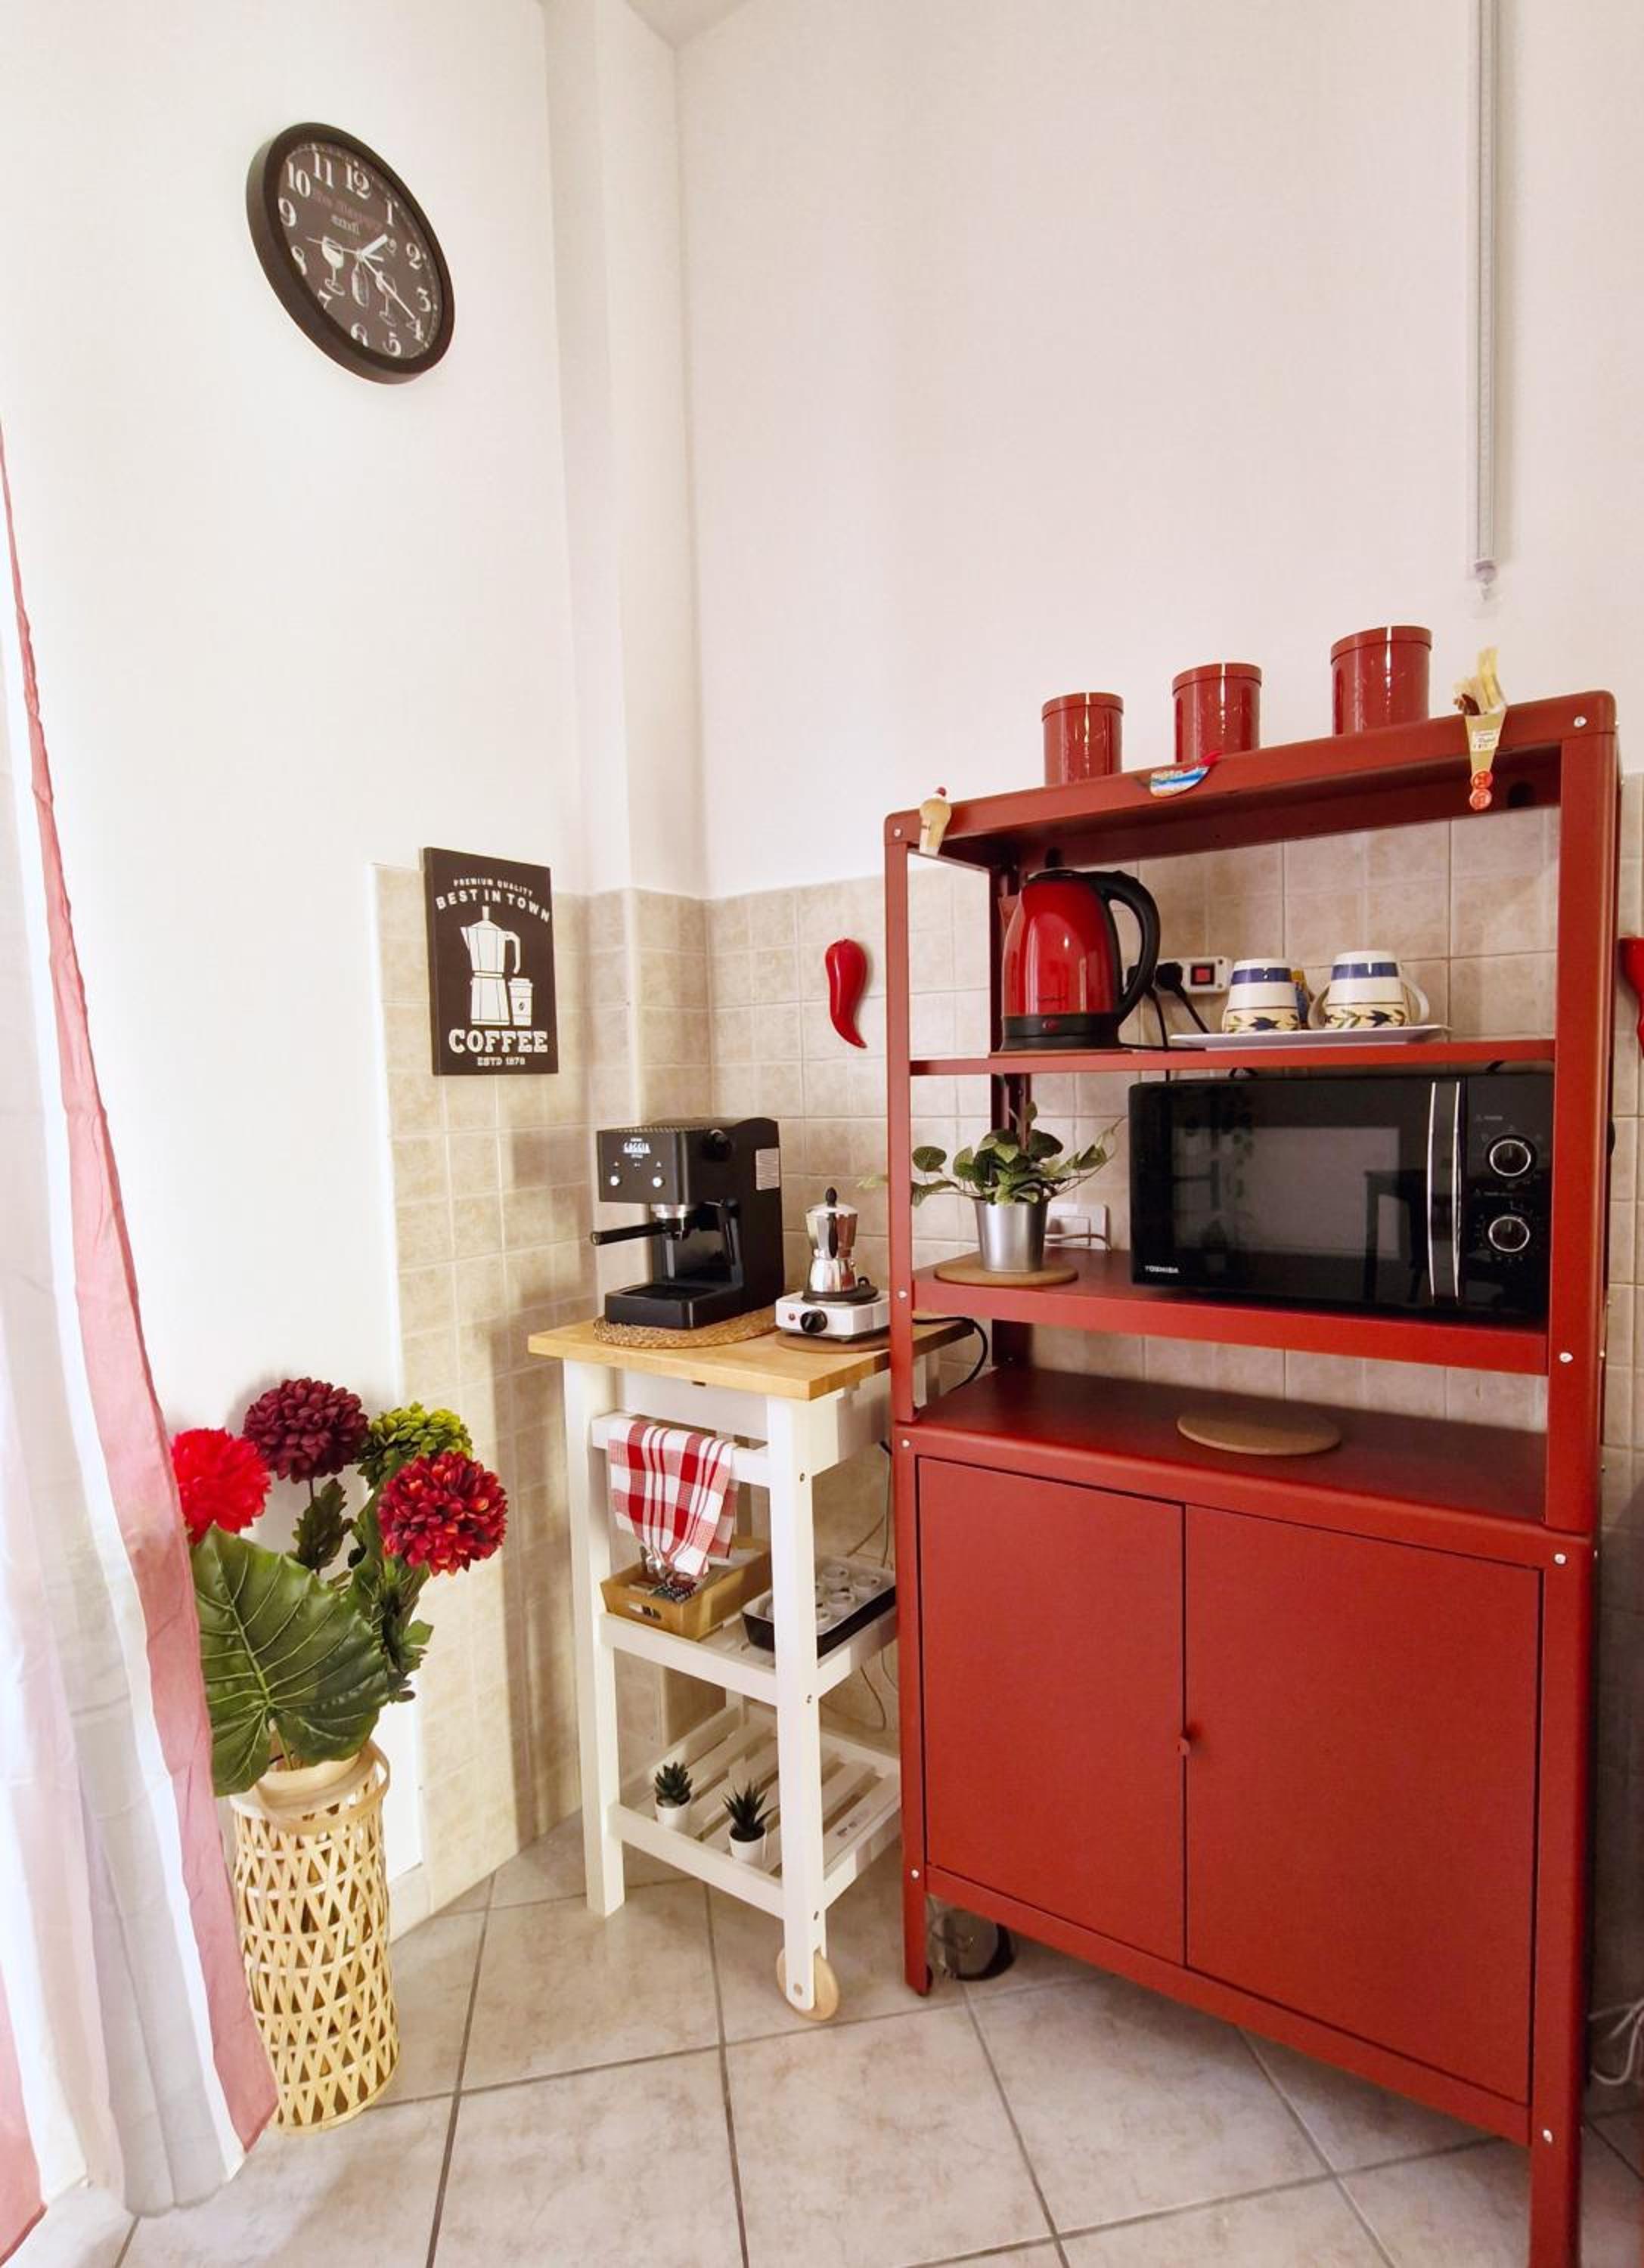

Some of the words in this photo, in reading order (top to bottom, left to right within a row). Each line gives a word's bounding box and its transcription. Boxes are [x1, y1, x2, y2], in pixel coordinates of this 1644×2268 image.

[286, 157, 311, 198] 10
[313, 150, 334, 189] 11
[345, 161, 371, 200] 12
[278, 197, 296, 227] 9
[384, 197, 394, 228] 1
[406, 242, 423, 270] 2
[417, 286, 432, 313] 3
[382, 330, 402, 357] 5
[405, 318, 424, 343] 4
[454, 877, 494, 887] PREMIUM
[497, 880, 533, 897] QUALITY
[436, 888, 479, 910] BEST
[484, 888, 501, 903] IN
[507, 893, 551, 922] TOWN
[448, 1029, 547, 1053] COFFEE
[1145, 1265, 1179, 1274] TOSHIBA
